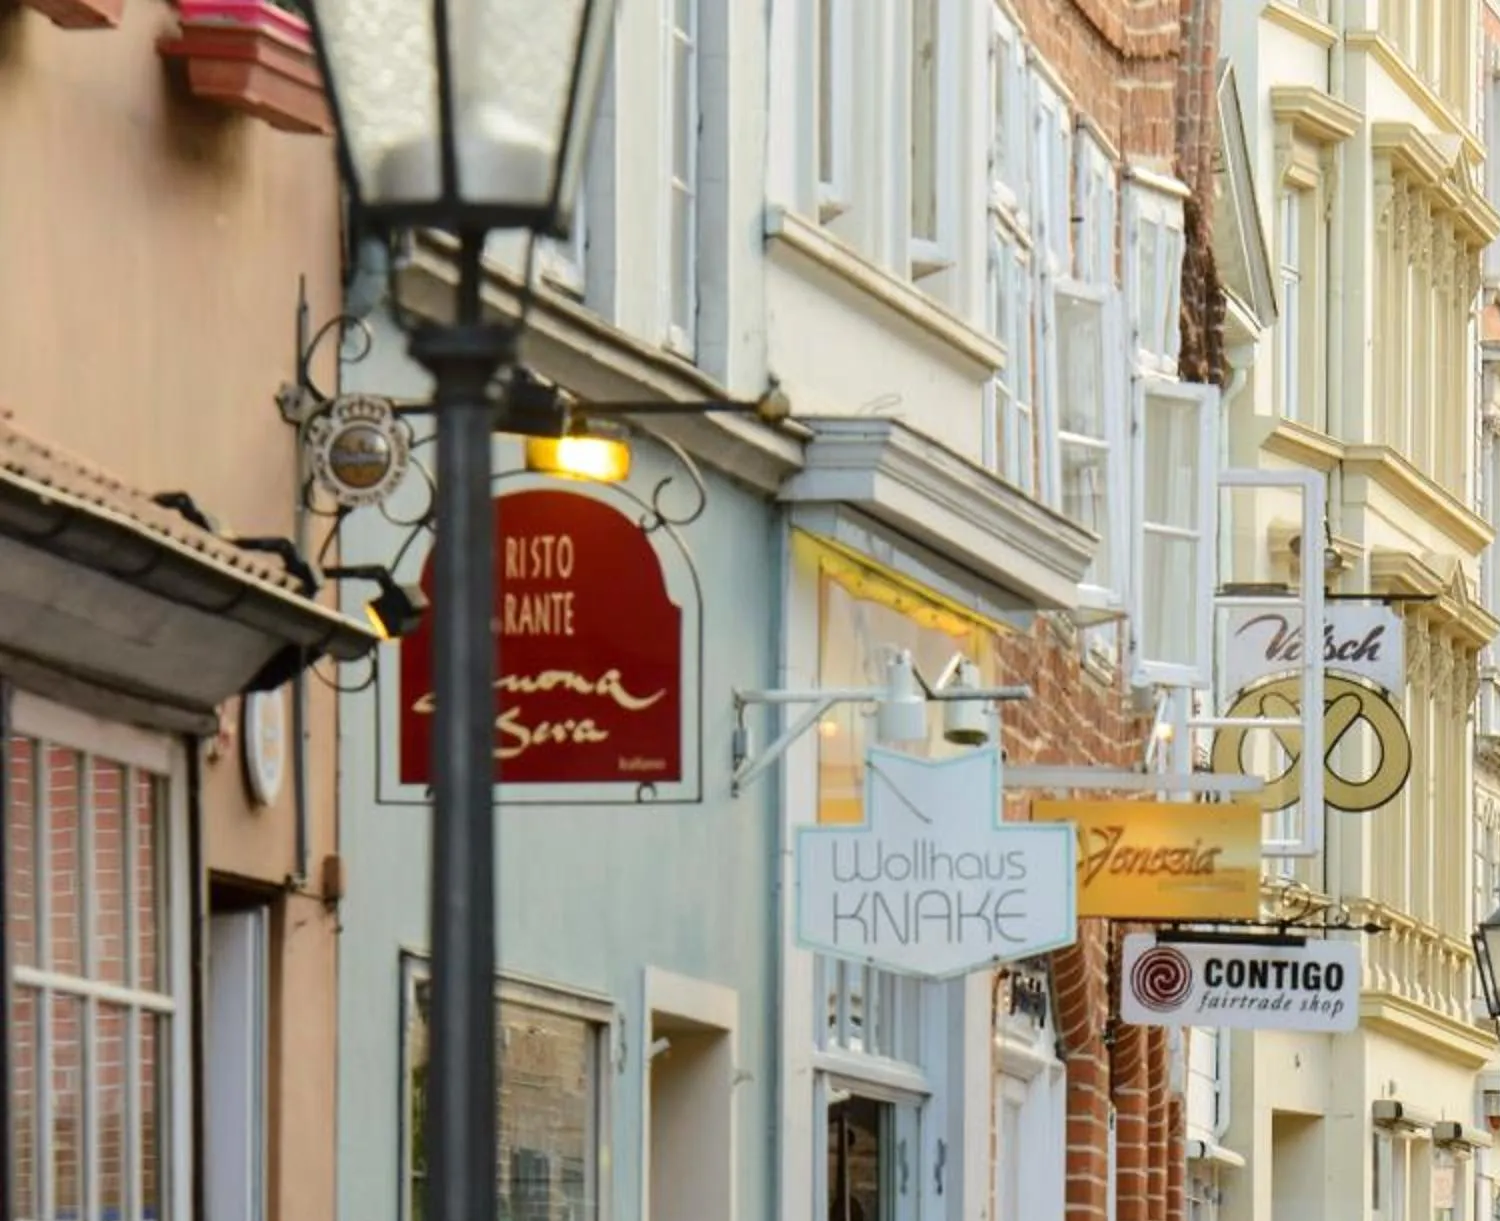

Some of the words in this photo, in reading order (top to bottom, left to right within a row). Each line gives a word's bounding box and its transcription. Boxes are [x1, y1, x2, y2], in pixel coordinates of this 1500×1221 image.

[504, 534, 575, 579] RISTO
[412, 668, 666, 711] uona
[493, 706, 609, 759] Sera
[832, 838, 1027, 882] Wollhaus
[1083, 826, 1223, 888] Venezia
[832, 889, 1028, 945] KNAKE
[1203, 957, 1344, 992] CONTIGO
[1197, 991, 1292, 1014] fairtrade
[1299, 993, 1345, 1018] shop
